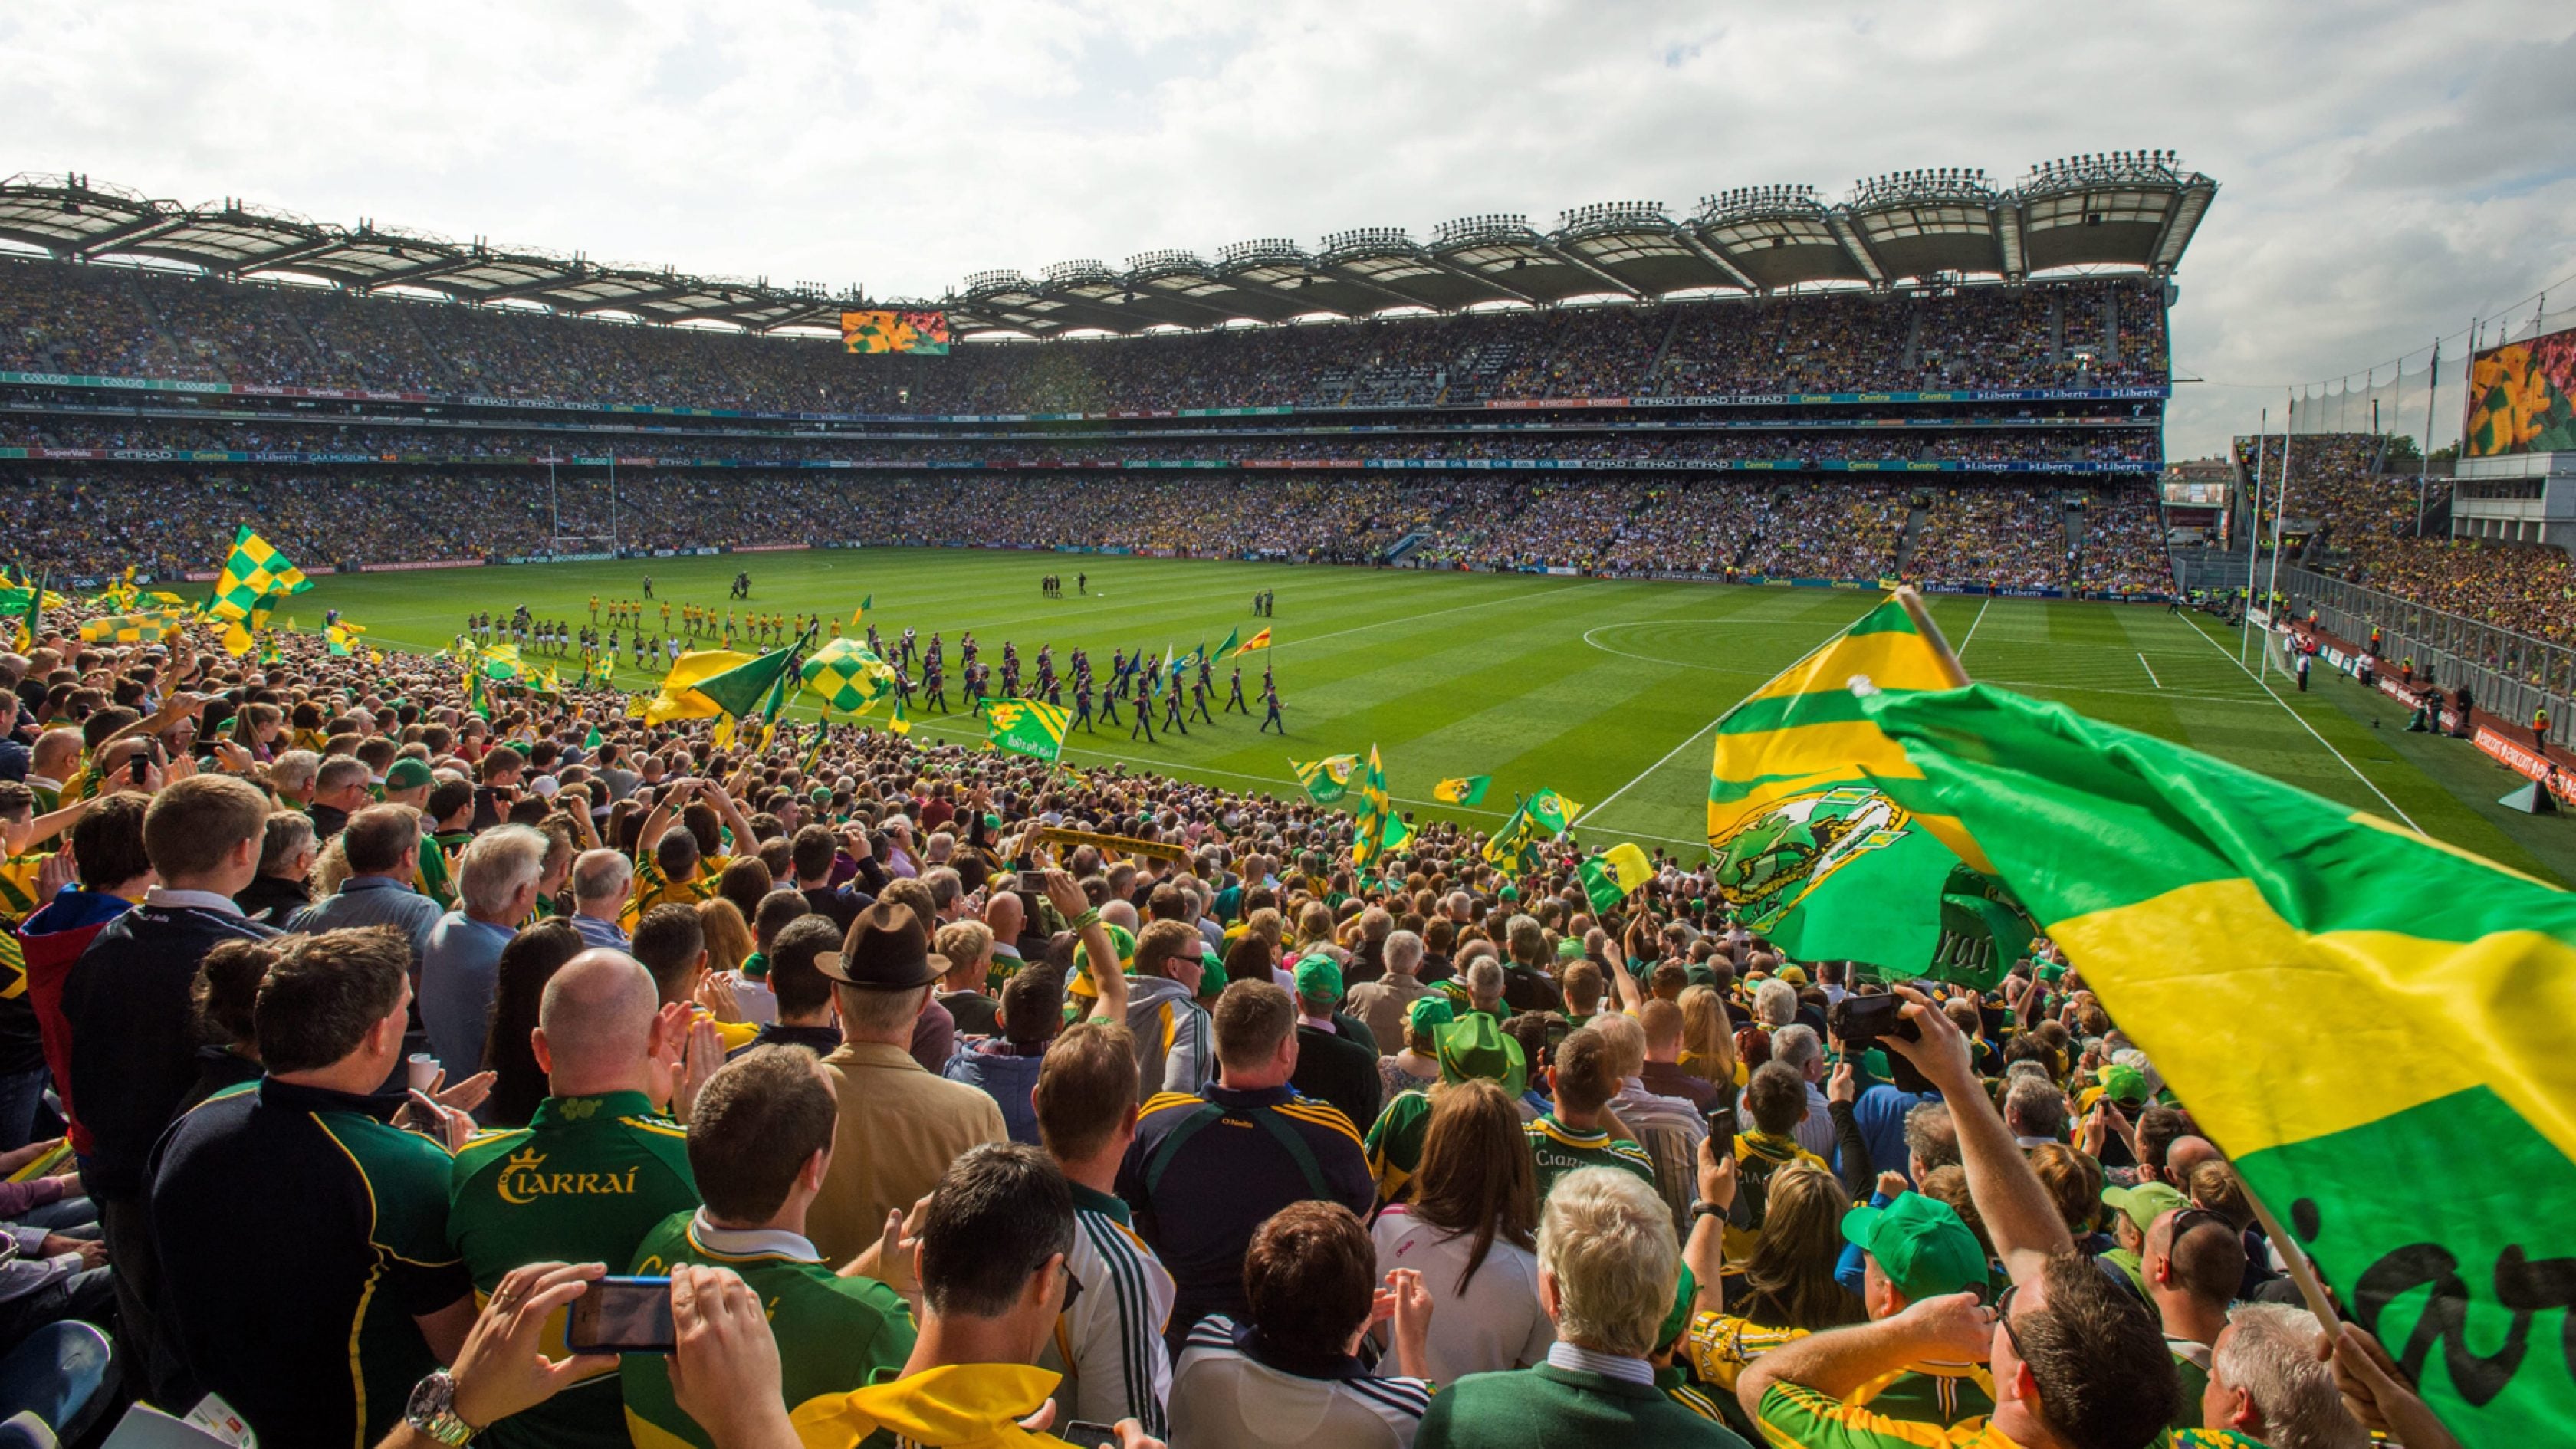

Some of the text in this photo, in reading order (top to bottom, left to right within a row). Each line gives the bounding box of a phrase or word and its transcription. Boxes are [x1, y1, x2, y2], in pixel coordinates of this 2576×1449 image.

[1984, 390, 2022, 399] Liberty
[2049, 389, 2090, 399] Liberty
[2119, 388, 2160, 398] Liberty
[44, 449, 92, 458] SuperValu
[114, 451, 172, 459] ETIHAD
[1971, 462, 2009, 471] Liberty
[2036, 462, 2074, 471] Liberty
[2104, 462, 2144, 471] Liberty
[1932, 584, 1964, 593] Liberty
[2009, 588, 2042, 597] Liberty
